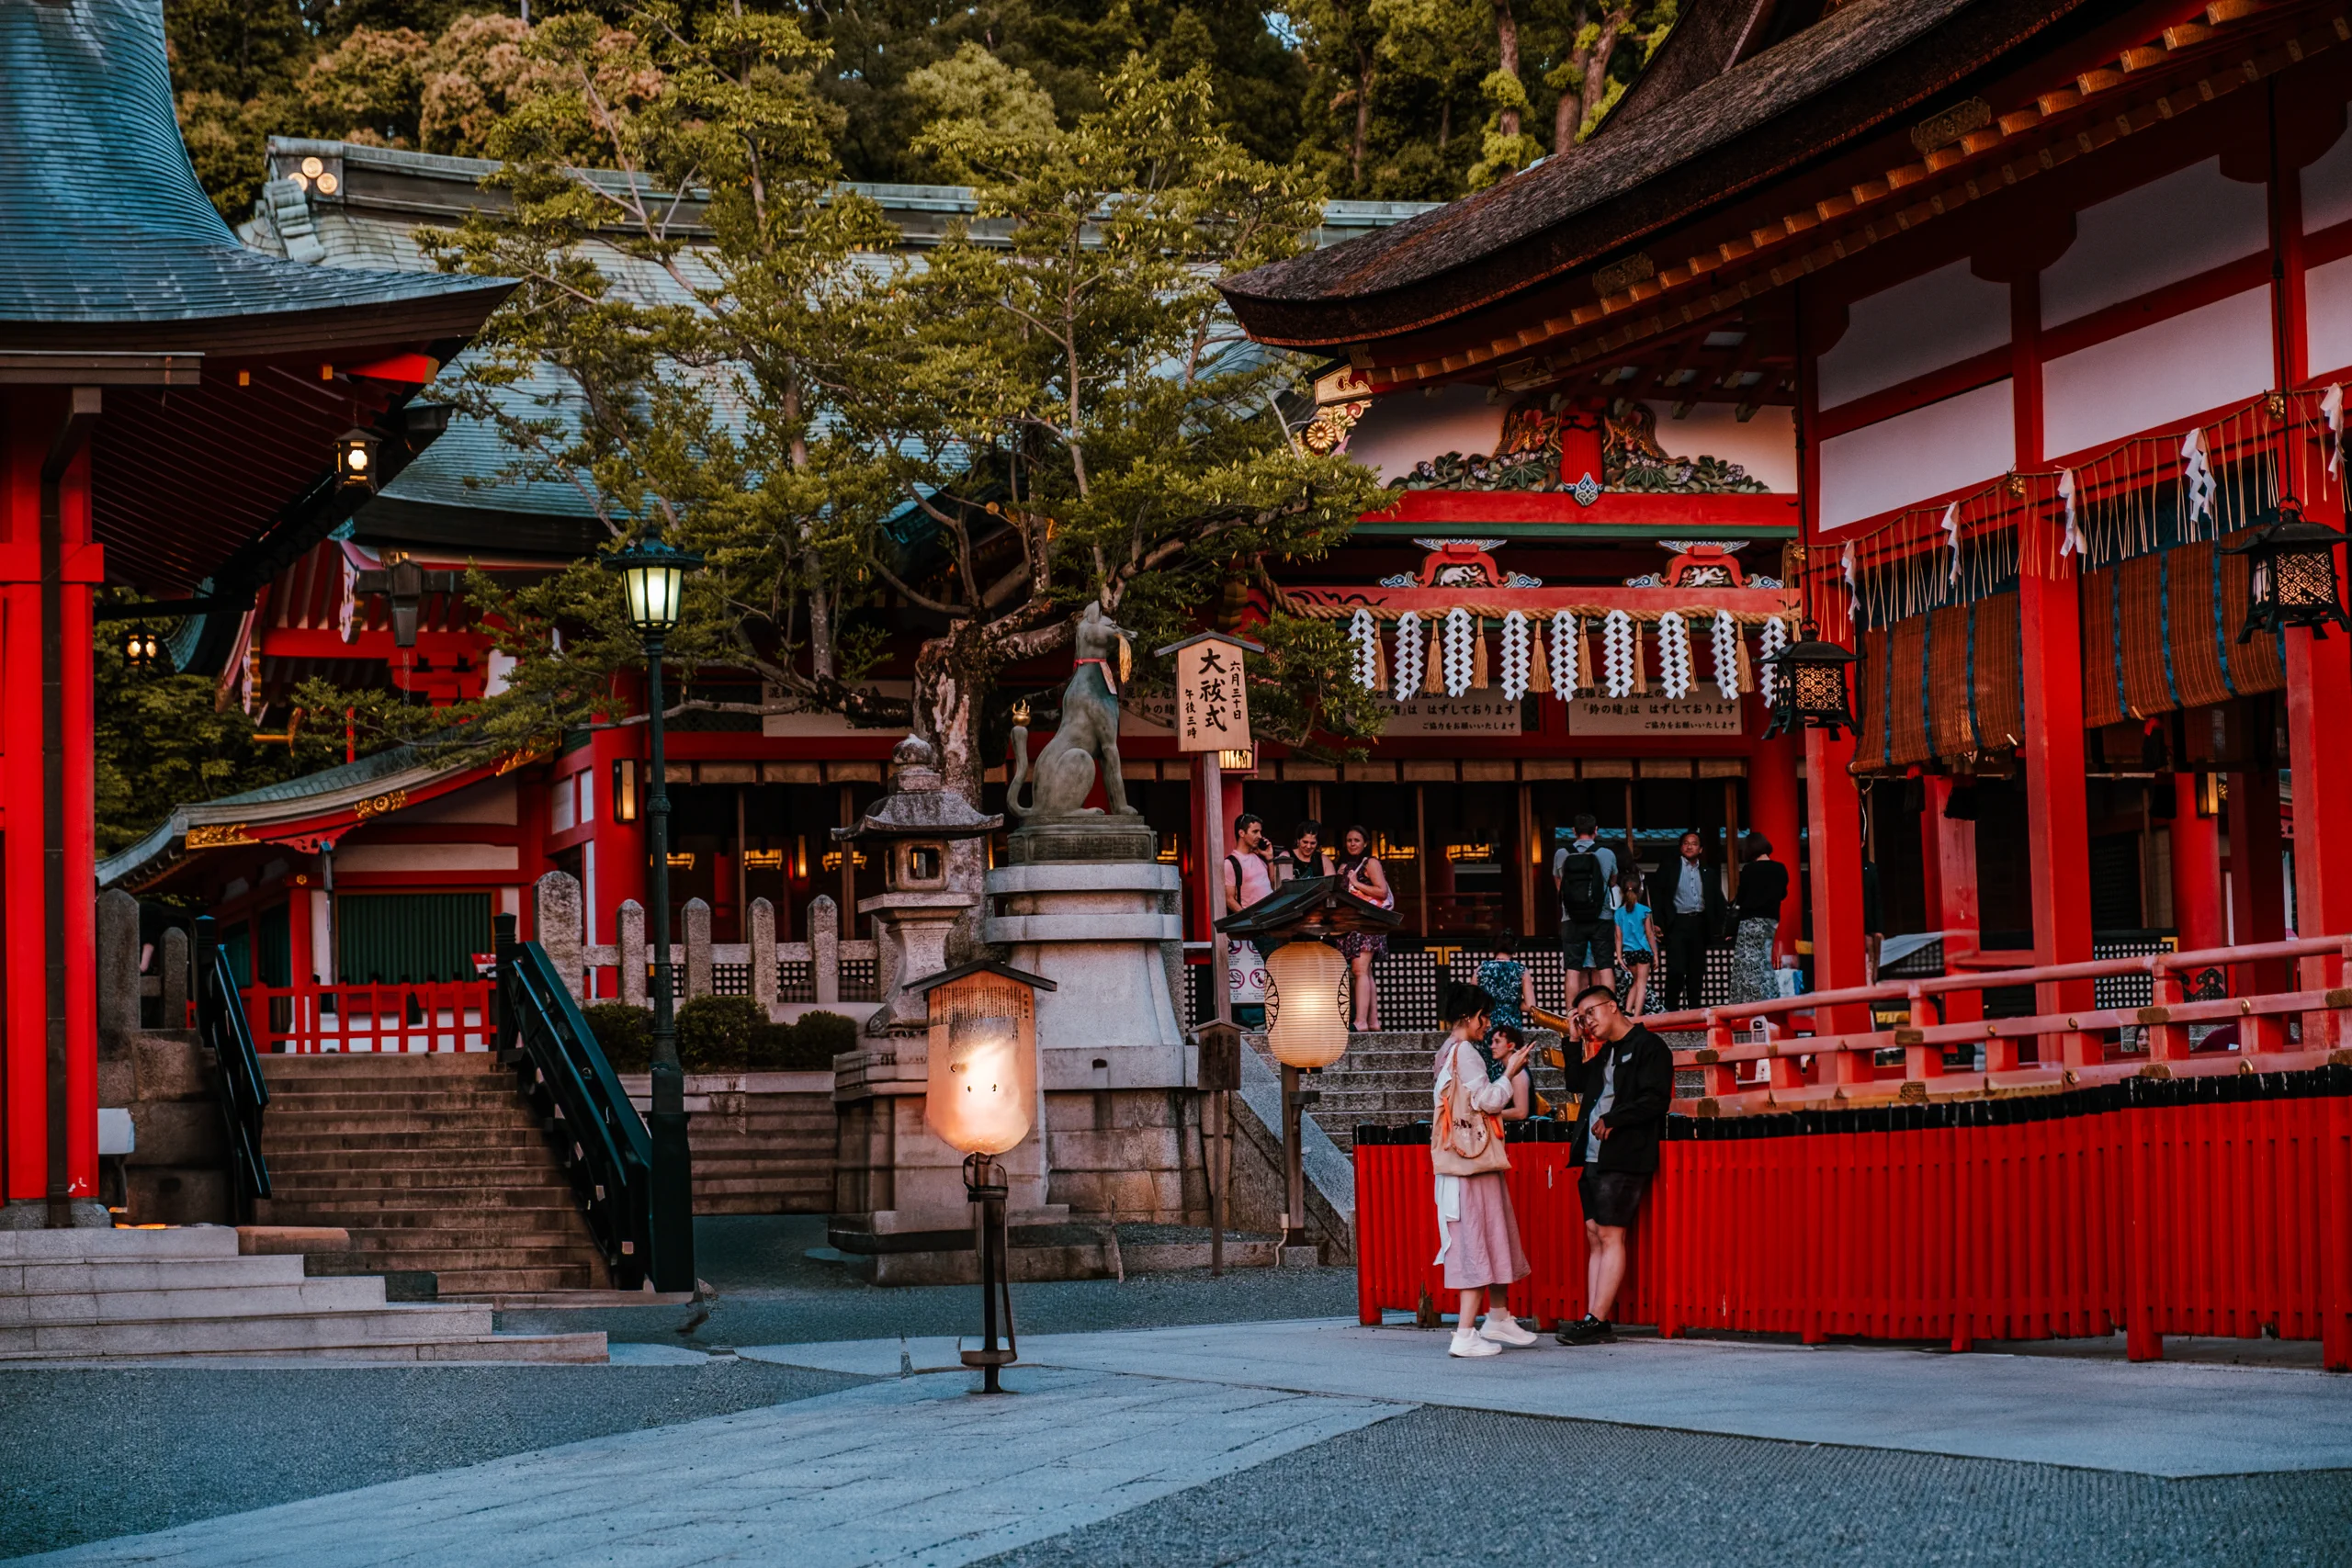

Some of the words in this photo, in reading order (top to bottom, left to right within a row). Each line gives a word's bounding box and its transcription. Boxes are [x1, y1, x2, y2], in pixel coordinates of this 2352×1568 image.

[1198, 648, 1227, 732] 大祓式
[1229, 660, 1242, 720] 六月三十日
[1185, 688, 1197, 739] 午後三時
[1428, 704, 1515, 715] はずしております
[1649, 703, 1736, 715] はずしております
[1422, 721, 1516, 730] ご協力をお願いいたします
[1645, 721, 1736, 729] ご協力をお願いいたします
